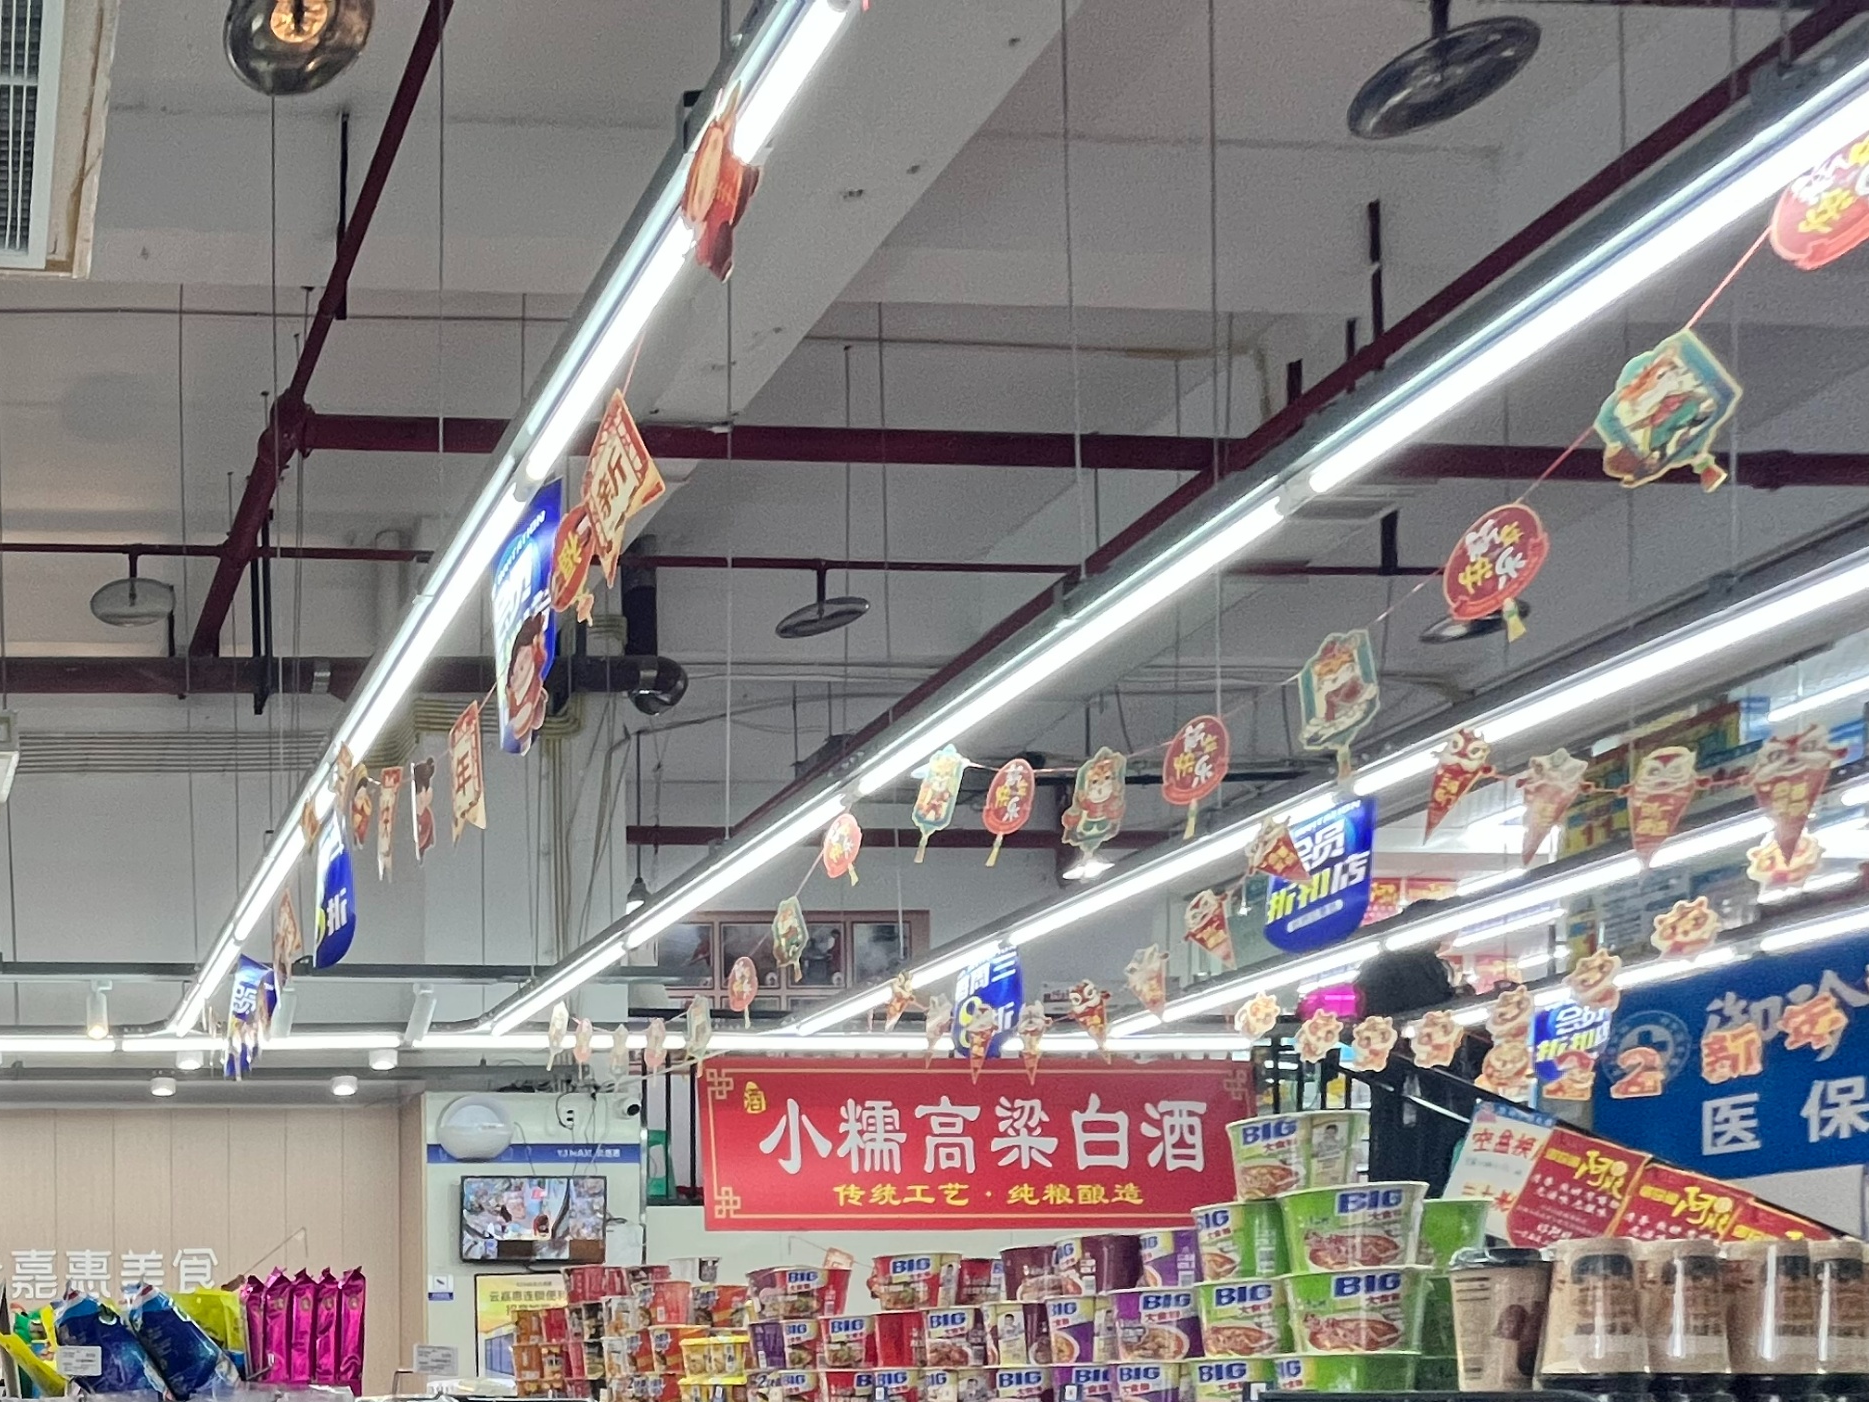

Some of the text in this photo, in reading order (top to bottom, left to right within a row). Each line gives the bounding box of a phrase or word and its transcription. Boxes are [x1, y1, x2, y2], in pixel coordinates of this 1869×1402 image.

[1701, 1023, 1762, 1085] 新
[759, 1093, 1208, 1176] 小糯高粱白酒
[1241, 1118, 1297, 1146] BIG
[1336, 1188, 1404, 1214] BIG
[891, 1258, 930, 1274] BIG
[787, 1270, 818, 1284] BIG
[1334, 1272, 1402, 1297] BIG
[1142, 1292, 1192, 1311] BIG
[1214, 1283, 1273, 1307] BIG
[830, 1318, 866, 1332] BIG
[929, 1312, 966, 1328] BIG
[1118, 1366, 1161, 1382] BIG
[1198, 1362, 1247, 1382] BIG
[1278, 1359, 1302, 1378] IG
[998, 1370, 1042, 1388] BIG
